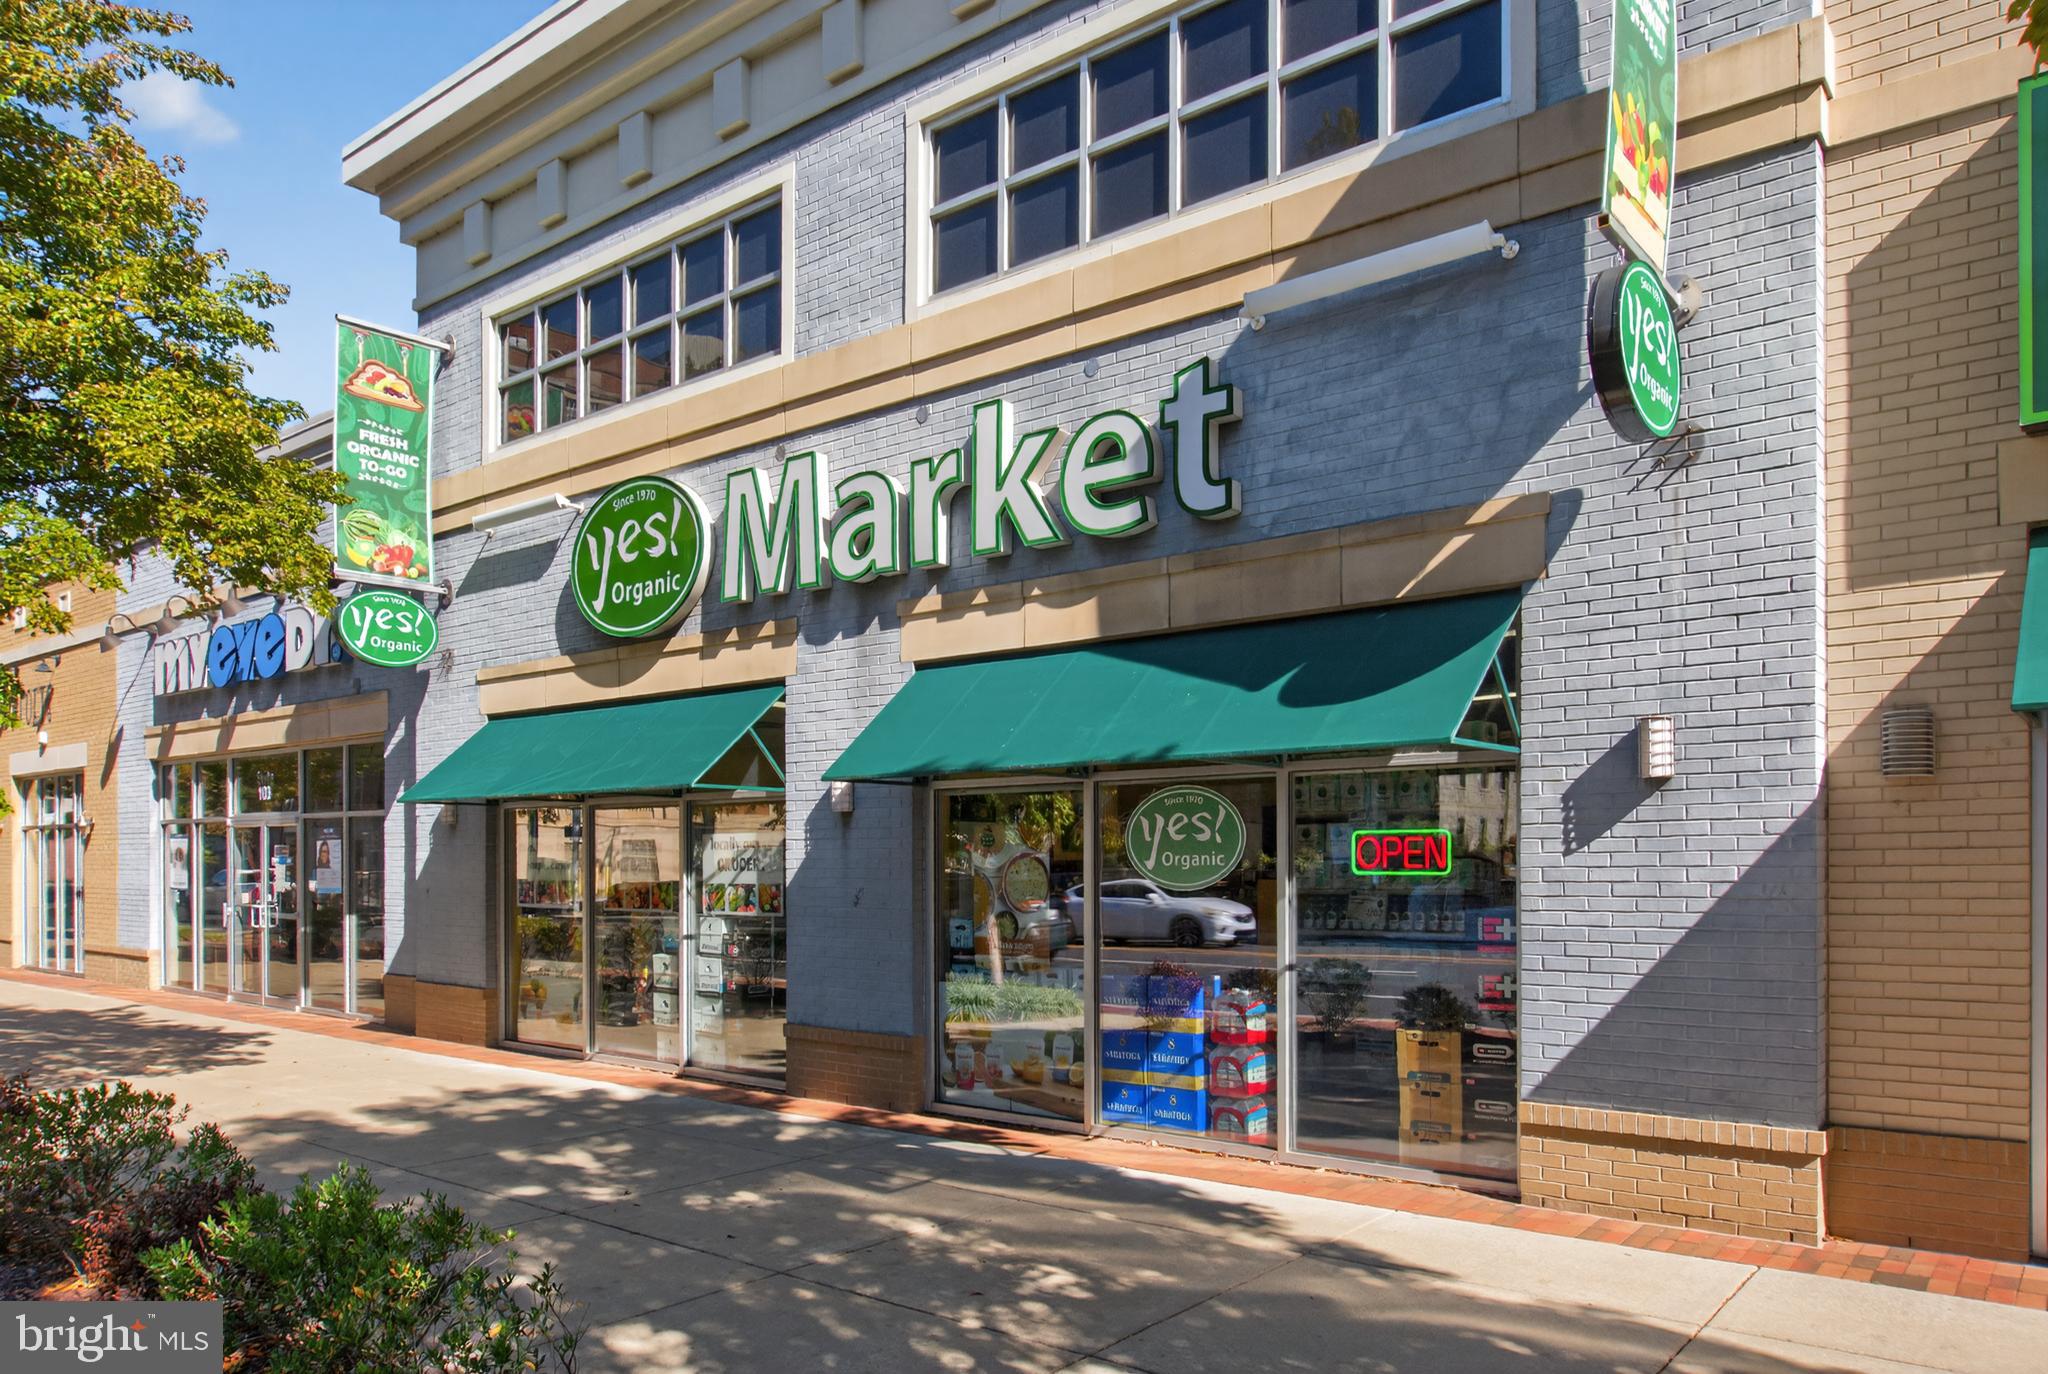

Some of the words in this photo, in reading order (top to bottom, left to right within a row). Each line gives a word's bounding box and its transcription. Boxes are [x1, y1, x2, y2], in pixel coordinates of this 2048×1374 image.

[1626, 287, 1673, 385] yes!
[1639, 362, 1673, 413] Organic
[346, 440, 420, 468] ORGANIC
[359, 428, 409, 451] FRESH
[358, 457, 408, 479] TO-GO
[721, 356, 1239, 604] Market
[612, 494, 635, 512] Since
[636, 489, 656, 502] 1970
[585, 496, 683, 614] yes!
[611, 569, 682, 606] Organic
[350, 604, 425, 649] yes!
[369, 635, 424, 654] Organic
[1140, 804, 1227, 871] yes!
[1356, 835, 1447, 870] OPEN
[1161, 850, 1226, 870] Organic
